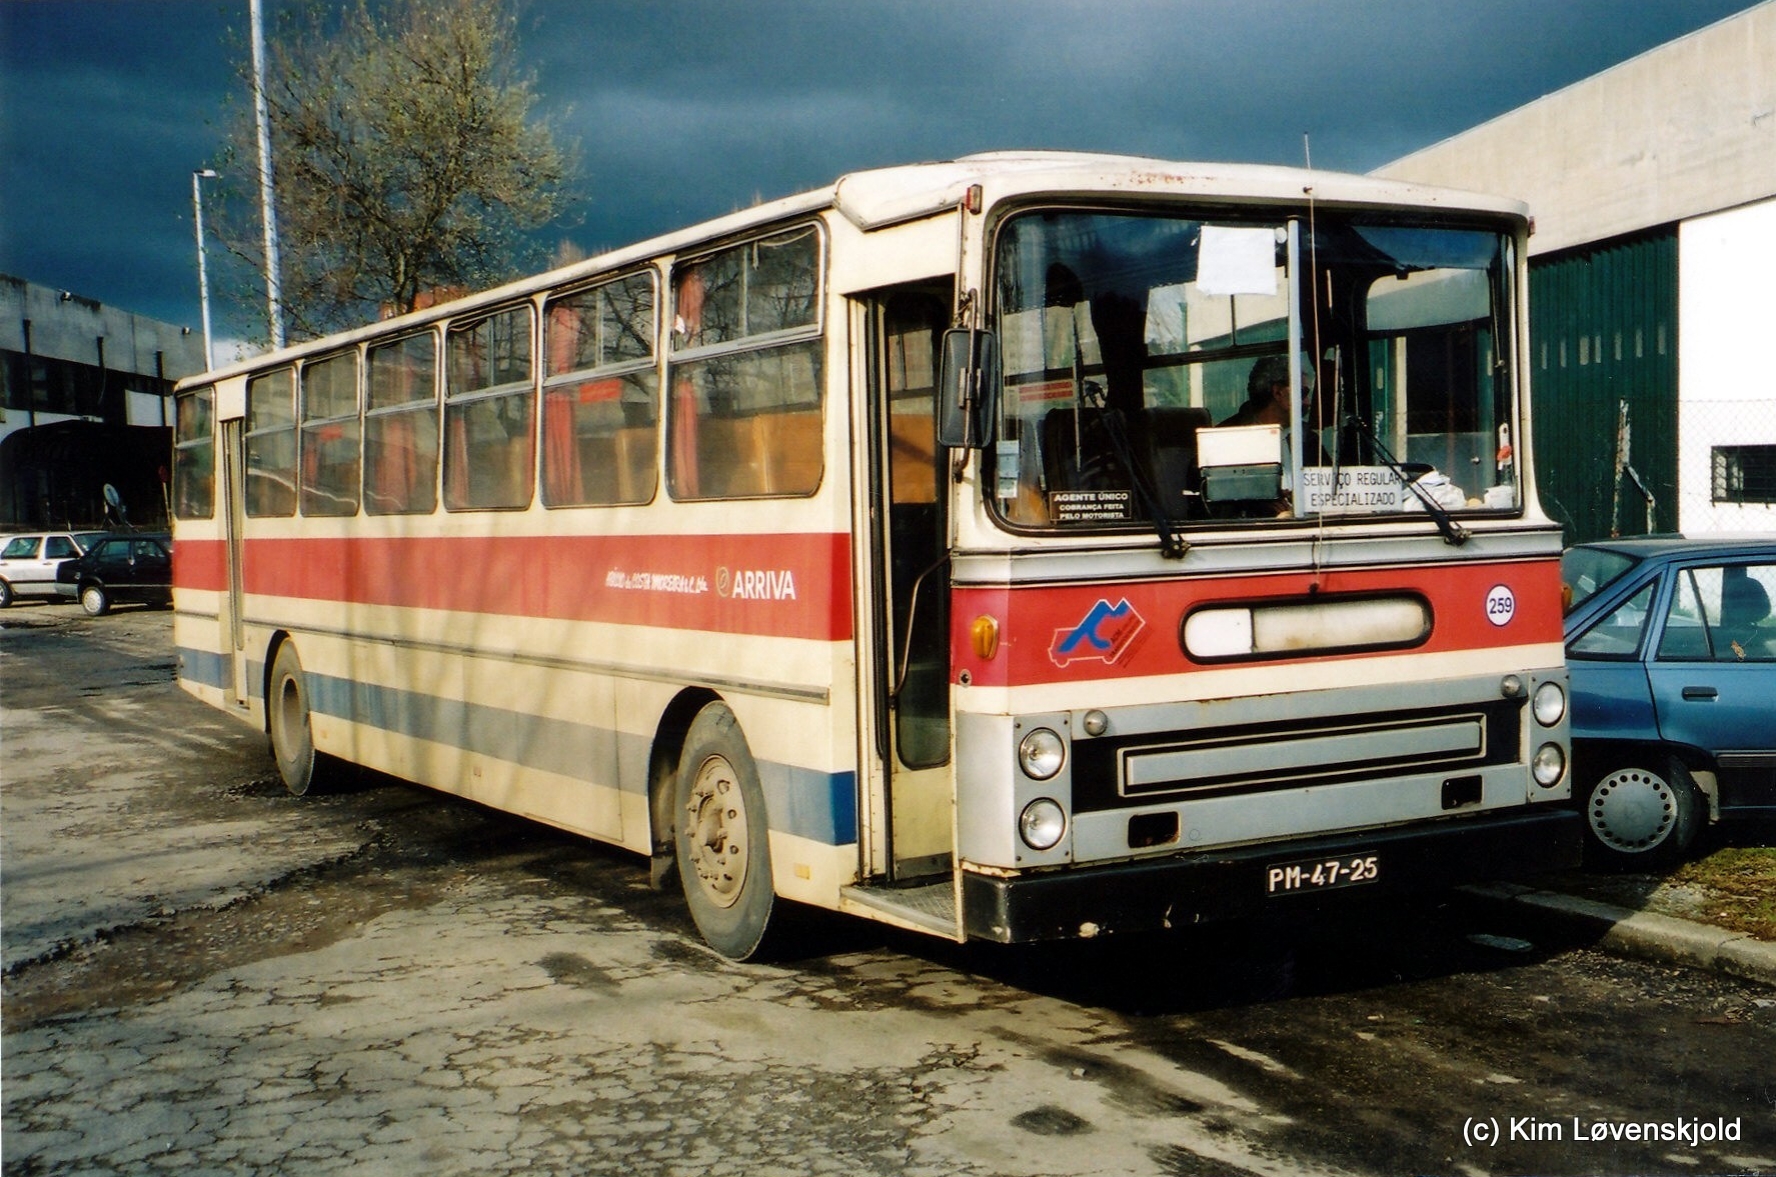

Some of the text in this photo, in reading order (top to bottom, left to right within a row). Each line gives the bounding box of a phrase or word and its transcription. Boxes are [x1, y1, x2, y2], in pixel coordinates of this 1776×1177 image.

[1303, 473, 1351, 489] SERVÇO
[1098, 492, 1128, 500] ÚNICO
[1311, 492, 1395, 506] ESPECIALIZADO
[732, 570, 796, 600] ARRIVA
[1489, 597, 1512, 614] 259
[1269, 857, 1378, 892] PM-47-25
